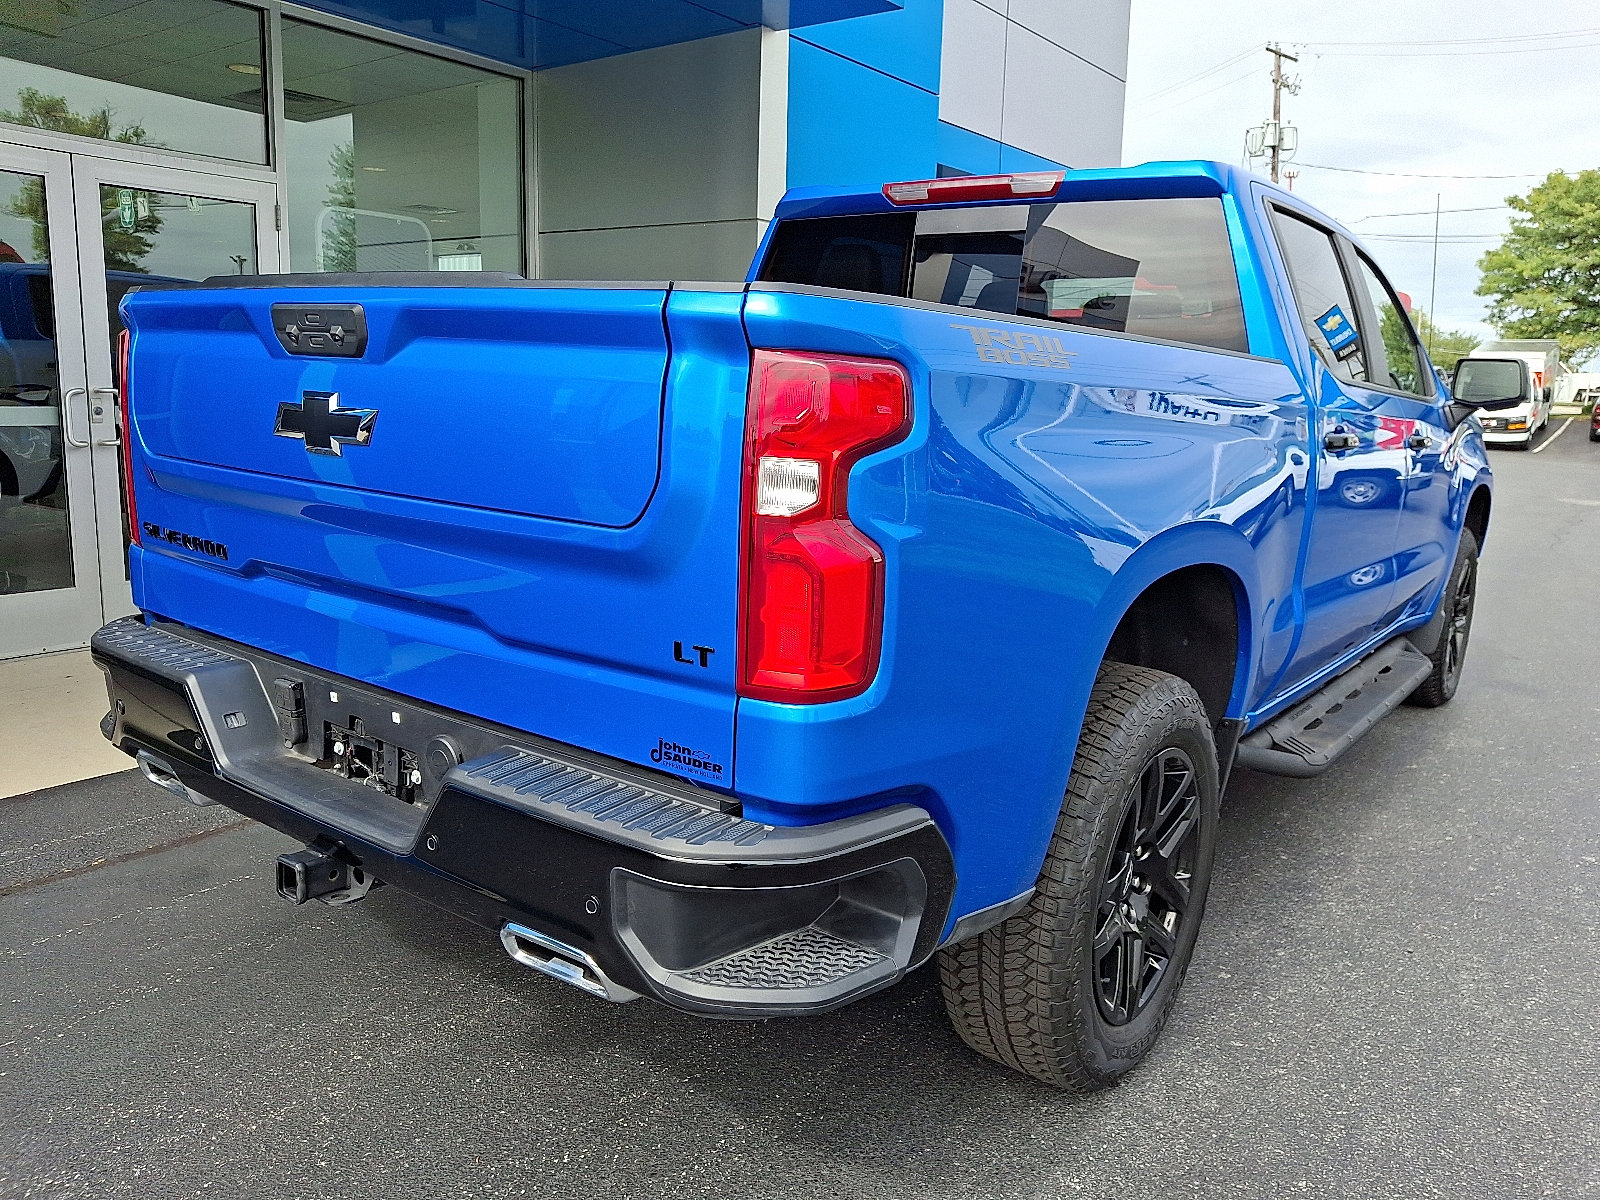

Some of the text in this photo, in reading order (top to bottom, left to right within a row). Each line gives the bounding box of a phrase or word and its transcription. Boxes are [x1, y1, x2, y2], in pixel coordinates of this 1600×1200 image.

[949, 323, 1079, 356] TRAIL
[977, 346, 1070, 370] BOSS
[143, 521, 229, 561] SILVERADO
[673, 640, 715, 668] LT
[664, 750, 723, 775] SAUDER
